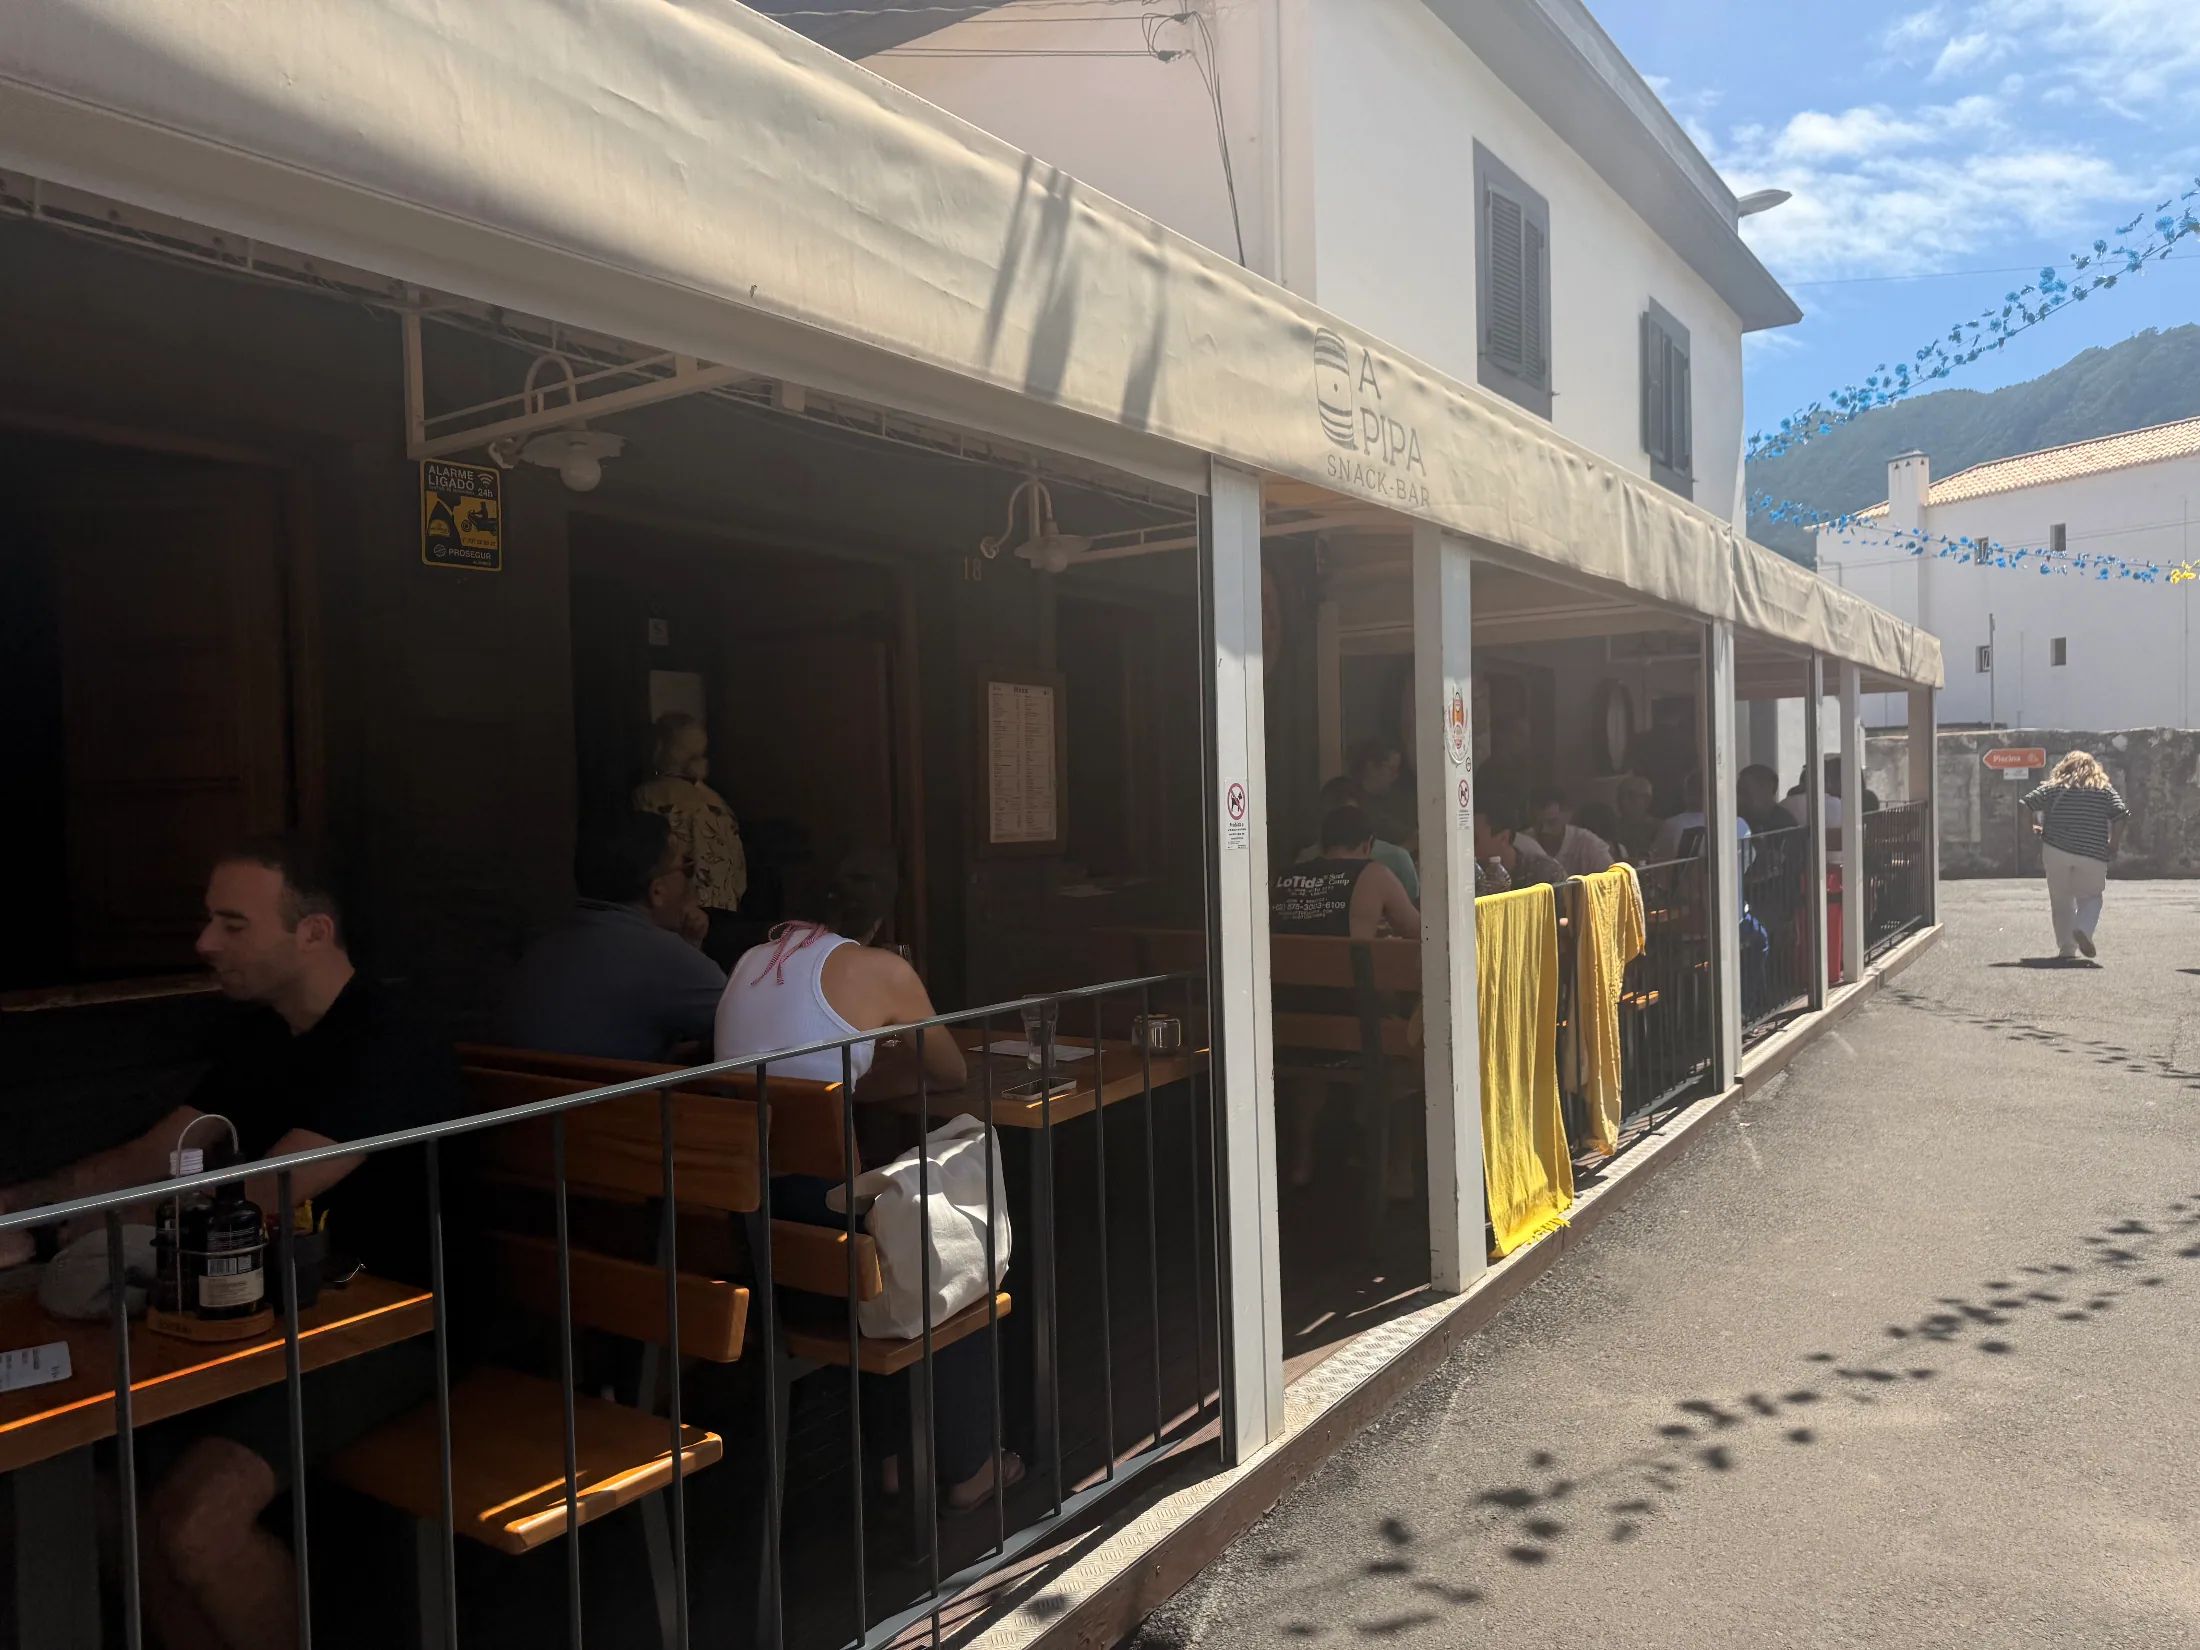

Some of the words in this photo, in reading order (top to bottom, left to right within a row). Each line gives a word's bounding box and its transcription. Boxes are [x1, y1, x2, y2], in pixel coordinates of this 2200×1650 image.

[1358, 348, 1382, 400] A
[1359, 407, 1427, 477] PIPA
[428, 465, 474, 480] ALARME
[428, 474, 475, 491] LIGADO
[1327, 454, 1431, 507] SNACK-BAR
[477, 488, 494, 498] 24h
[448, 548, 492, 560] PROSEGUR
[963, 557, 982, 581] 18
